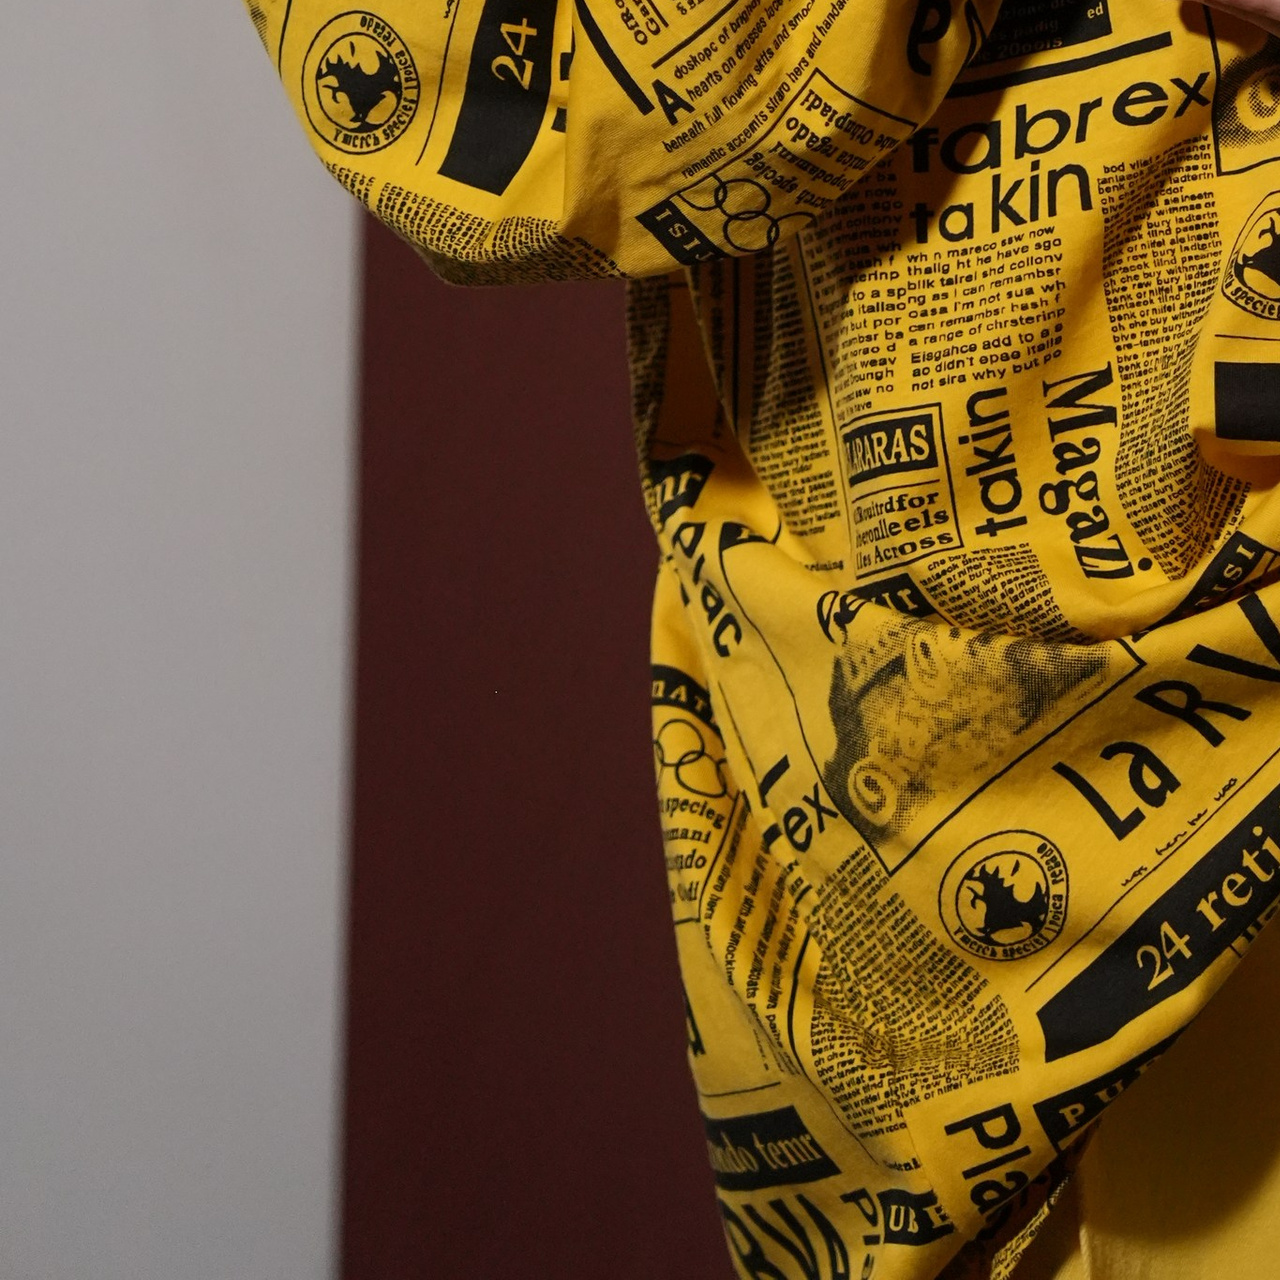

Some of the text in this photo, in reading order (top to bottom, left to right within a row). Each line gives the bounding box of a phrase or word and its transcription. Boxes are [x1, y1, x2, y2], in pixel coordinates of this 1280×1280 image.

[491, 18, 539, 91] 24
[806, 33, 822, 59] and
[662, 111, 706, 153] beneath
[773, 25, 790, 50] and
[908, 159, 1093, 244] takin
[1028, 225, 1056, 240] now
[996, 245, 1030, 263] have
[923, 329, 964, 346] range
[968, 324, 982, 337] of
[982, 334, 1013, 351] add
[911, 357, 1040, 392] not why but
[958, 387, 1028, 537] takin
[1040, 362, 1153, 580] Magazi
[874, 531, 955, 565] Across
[1136, 921, 1193, 991] 24
